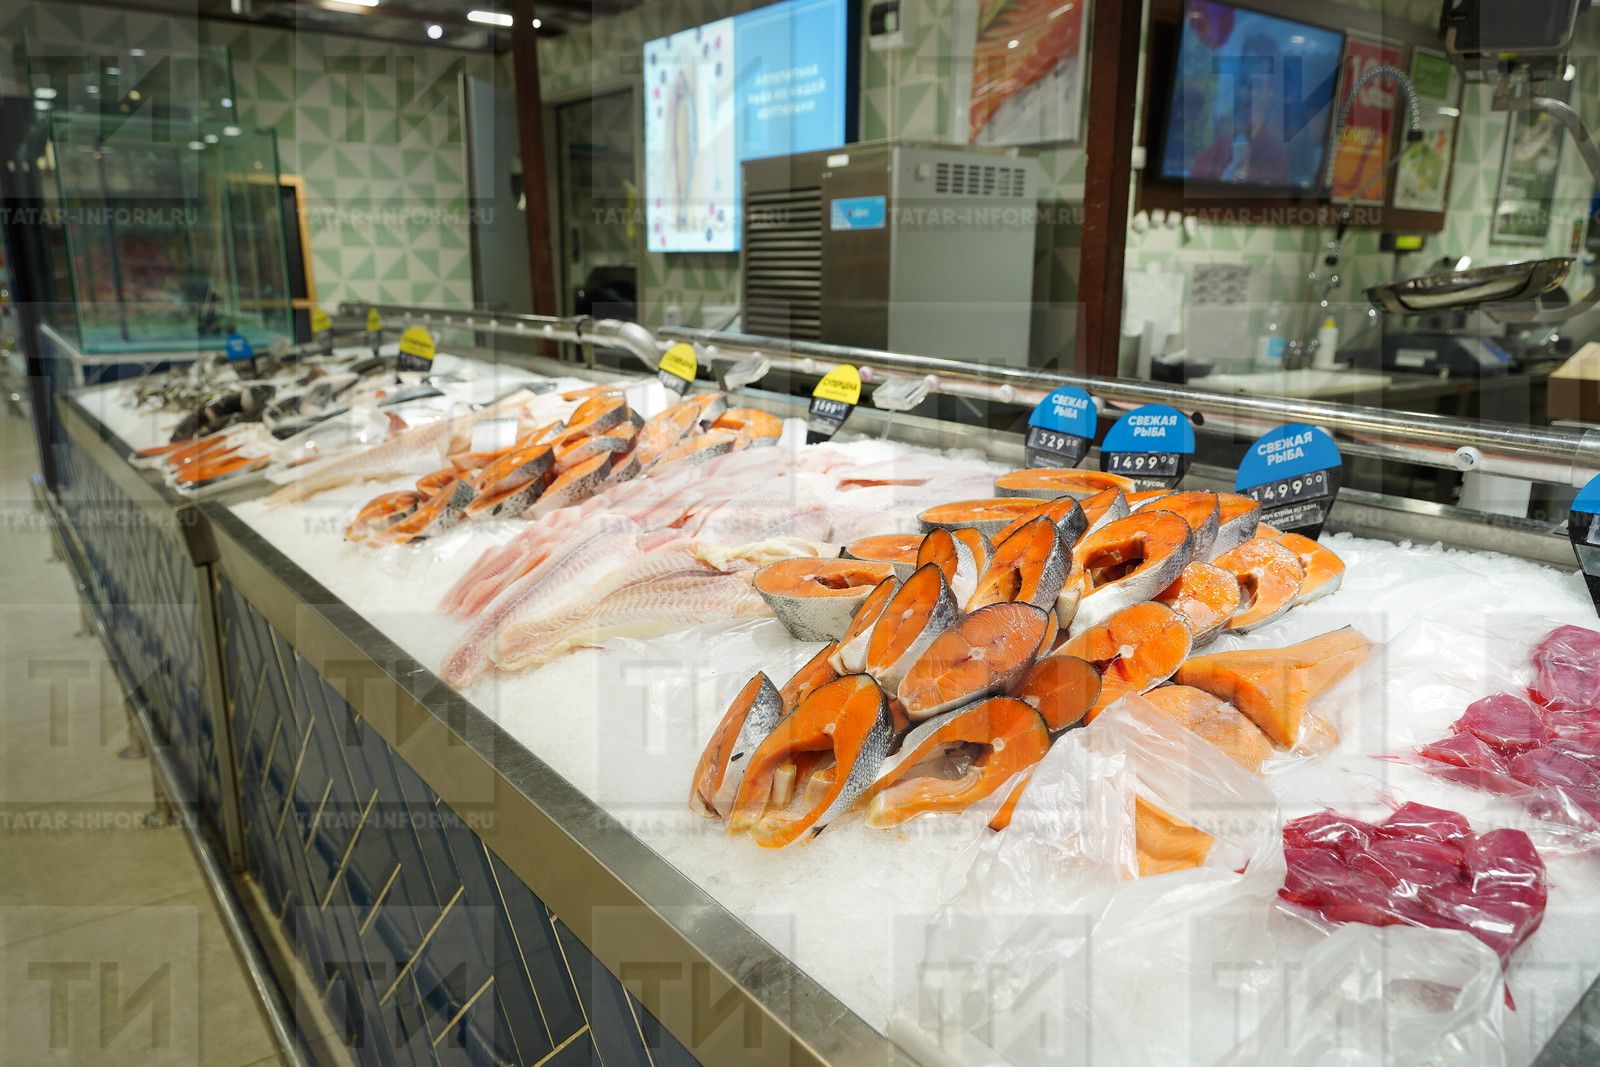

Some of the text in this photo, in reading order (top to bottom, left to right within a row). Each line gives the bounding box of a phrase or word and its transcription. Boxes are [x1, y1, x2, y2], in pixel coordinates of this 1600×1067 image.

[1051, 393, 1089, 410] СВЕЖАЯ
[1053, 405, 1078, 419] РЫБА
[1128, 415, 1177, 426] СВЕЖАЯ
[1133, 427, 1166, 437] РЫБА
[1256, 431, 1313, 456] СВЕЖАЯ
[1267, 447, 1304, 465] РЫБА
[1142, 480, 1166, 488] кусок
